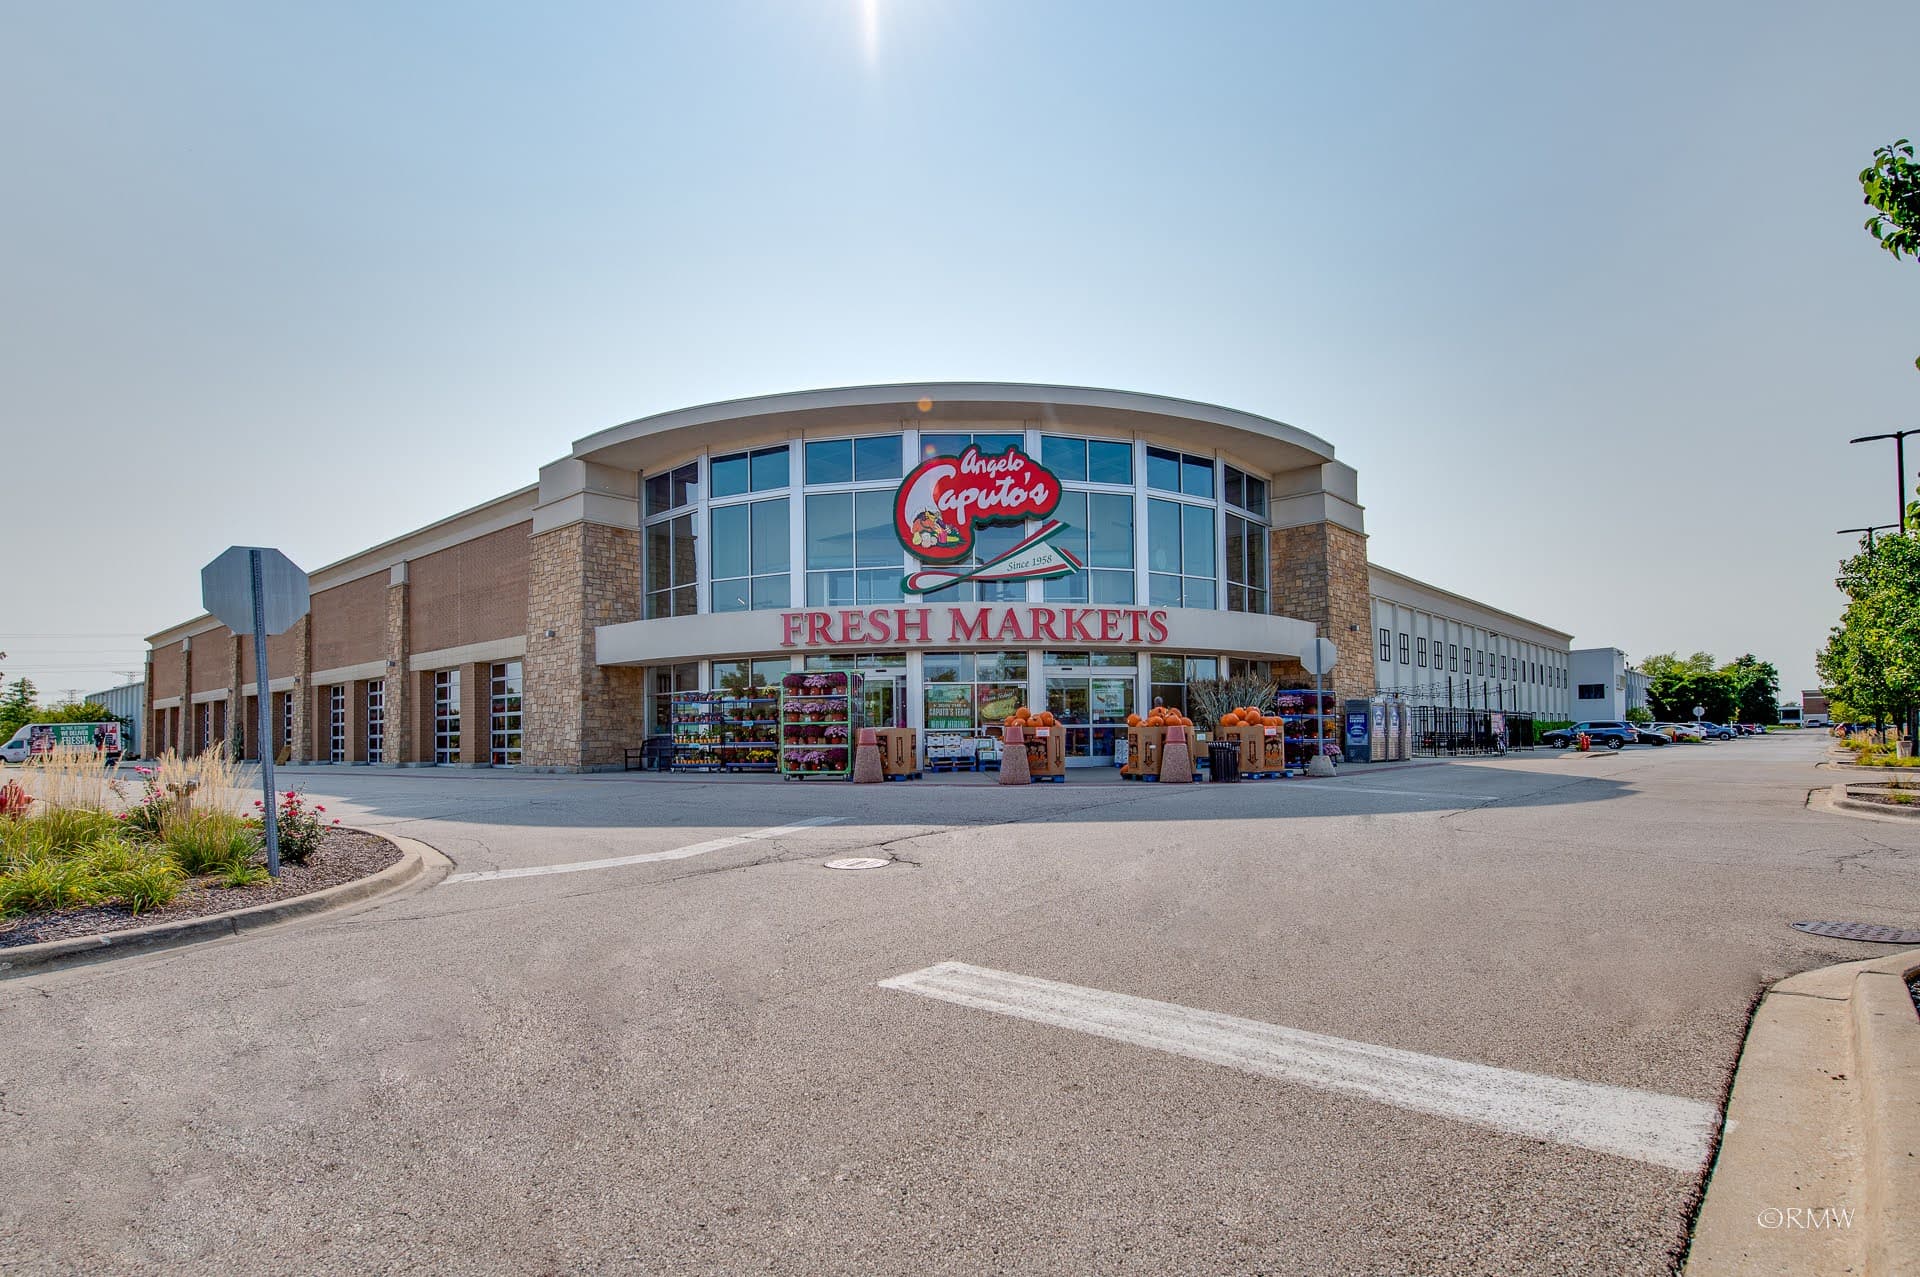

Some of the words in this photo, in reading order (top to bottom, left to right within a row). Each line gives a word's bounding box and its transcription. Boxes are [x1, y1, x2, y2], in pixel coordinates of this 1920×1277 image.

[961, 449, 1024, 478] Angelo
[905, 464, 1048, 532] Caputo's
[1007, 559, 1029, 571] Since
[1032, 555, 1052, 567] 1958
[780, 608, 932, 646] FRESH
[948, 607, 1168, 644] MARKETS
[929, 708, 953, 717] CAPUTO'S
[931, 720, 945, 728] NOW
[948, 720, 968, 728] HIRING
[61, 736, 88, 745] FRESH!
